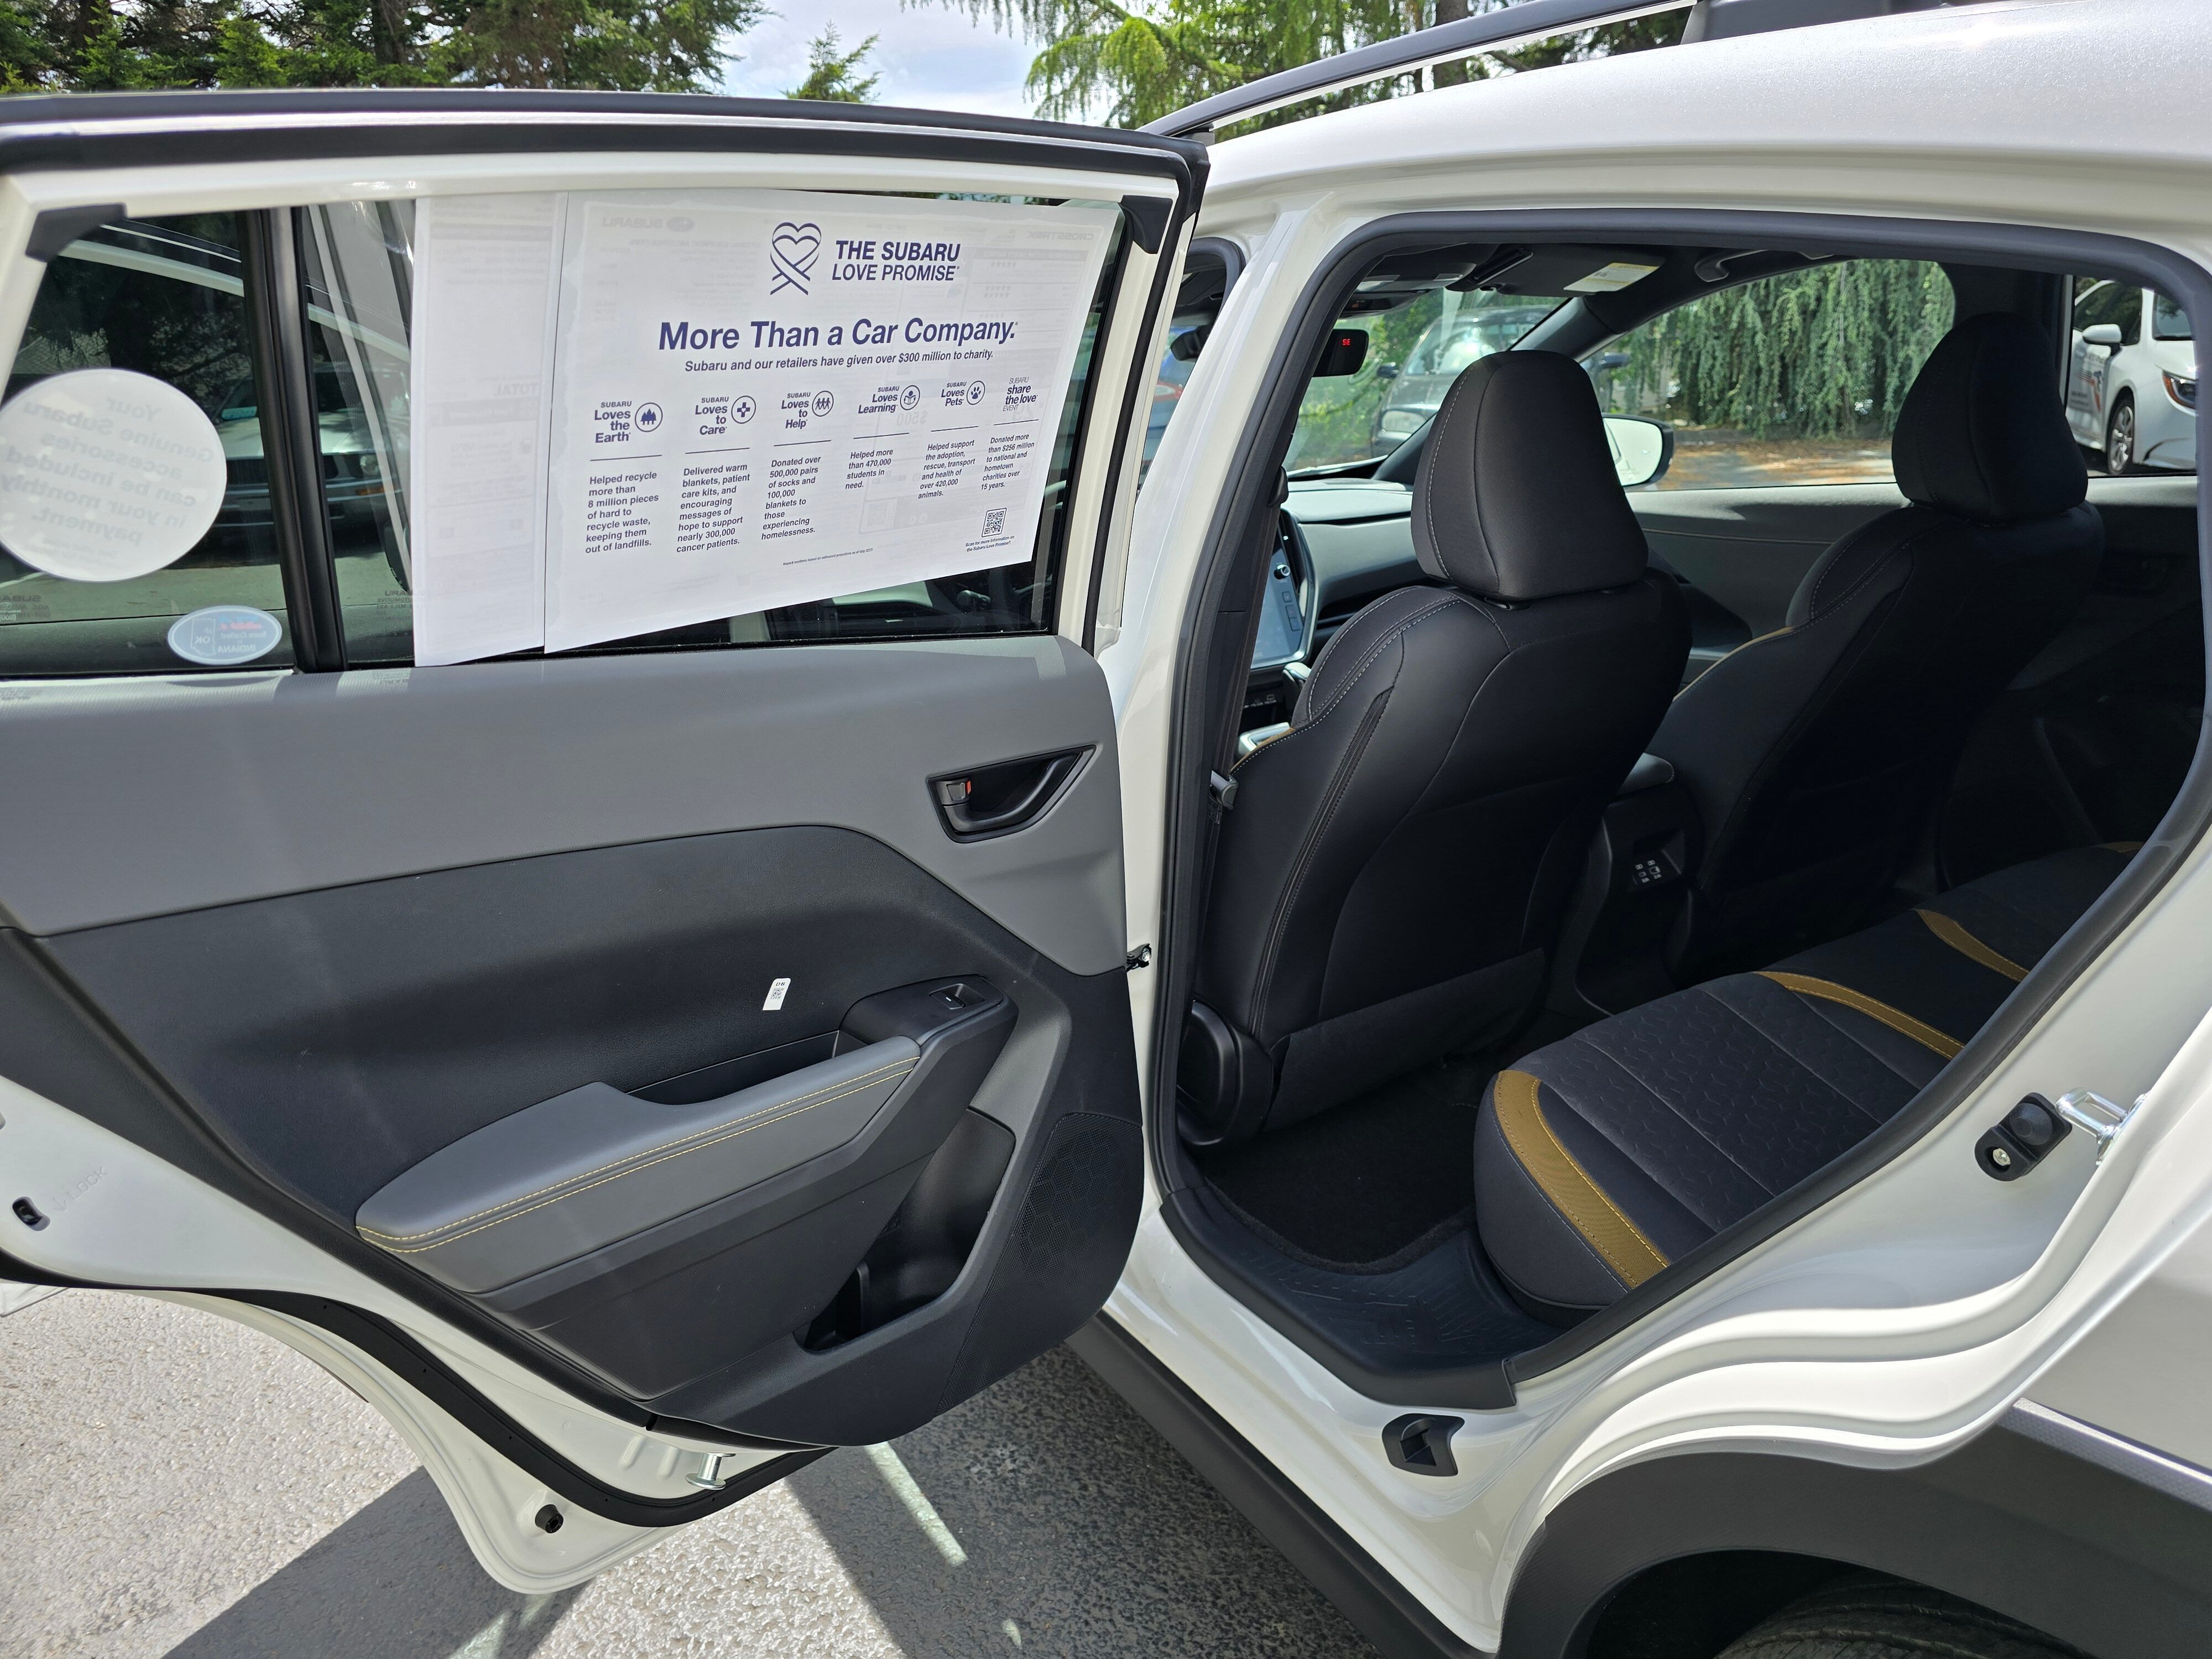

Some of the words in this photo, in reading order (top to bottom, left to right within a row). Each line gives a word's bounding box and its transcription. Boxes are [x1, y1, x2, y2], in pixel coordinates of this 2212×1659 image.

[836, 241, 876, 260] THE
[881, 242, 961, 262] SUBARU
[832, 264, 878, 280] LOVE
[881, 264, 956, 281] PROMISE
[659, 322, 739, 349] More
[750, 321, 817, 348] Than
[827, 326, 843, 346] a
[852, 319, 898, 345] Car
[905, 317, 1015, 346] Company.
[685, 361, 727, 372] Subaru
[731, 359, 752, 370] and
[755, 361, 773, 369] our
[776, 357, 817, 368] retailers
[821, 356, 844, 366] have
[847, 355, 873, 367] given
[899, 352, 920, 363] $300
[922, 351, 951, 361] million
[953, 351, 962, 359] to
[964, 349, 993, 361] charity.
[1009, 377, 1029, 385] SUBARU
[941, 389, 964, 398] Loves
[1007, 384, 1031, 395] share
[872, 394, 898, 403] Loves
[945, 398, 964, 406] Pets
[1005, 395, 1019, 405] the
[1020, 394, 1036, 404] love
[781, 400, 809, 409] Loves
[858, 403, 896, 414] Learning
[594, 410, 630, 420] Loves
[695, 405, 728, 415] Loves
[799, 409, 807, 418] to
[716, 415, 726, 424] to
[785, 419, 806, 429] Help
[610, 420, 630, 431] the
[700, 425, 725, 435] Care
[596, 431, 629, 443] Earth
[990, 435, 1014, 444] Donated
[927, 442, 950, 451] Helped
[951, 440, 974, 449] support
[1002, 444, 1015, 452] $256
[851, 450, 874, 460] Helped
[937, 451, 965, 460] adoption,
[994, 452, 1016, 462] national
[771, 457, 804, 467] Donated
[865, 458, 891, 468] 470,000
[948, 458, 975, 467] transport
[684, 465, 723, 476] Delivered
[770, 468, 798, 478] 500,000
[800, 467, 818, 477] pairs
[984, 463, 1013, 472] hometown
[590, 474, 623, 486] Helped
[625, 471, 657, 482] recycle
[847, 470, 877, 479] students
[935, 470, 954, 478] health
[983, 472, 1006, 481] charities
[683, 477, 720, 487] blankets,
[723, 474, 750, 486] patient
[778, 479, 800, 487] socks
[802, 476, 816, 484] and
[846, 481, 863, 489] need.
[935, 478, 958, 487] 420,000
[615, 486, 635, 494] than
[722, 486, 737, 494] and
[988, 482, 1005, 491] years.
[768, 489, 795, 499] 100,000
[918, 490, 943, 499] animals.
[597, 498, 627, 507] million
[630, 495, 659, 505] pieces
[681, 498, 732, 509] encouraging
[766, 500, 797, 509] blankets
[588, 511, 597, 519] of
[599, 509, 620, 518] hard
[680, 510, 721, 520] messages
[587, 520, 619, 531] recycle
[623, 518, 650, 526] waste,
[712, 517, 743, 528] support
[763, 518, 810, 530] experiencing
[586, 532, 622, 542] keeping
[677, 533, 703, 542] nearly
[706, 528, 735, 538] 300,000
[761, 528, 815, 540] homelessness.
[586, 545, 601, 553] out
[603, 542, 612, 551] of
[615, 539, 651, 550] landfills.
[677, 544, 705, 552] cancer
[707, 538, 739, 550] patients.
[67, 1165, 108, 1200] LOCK
